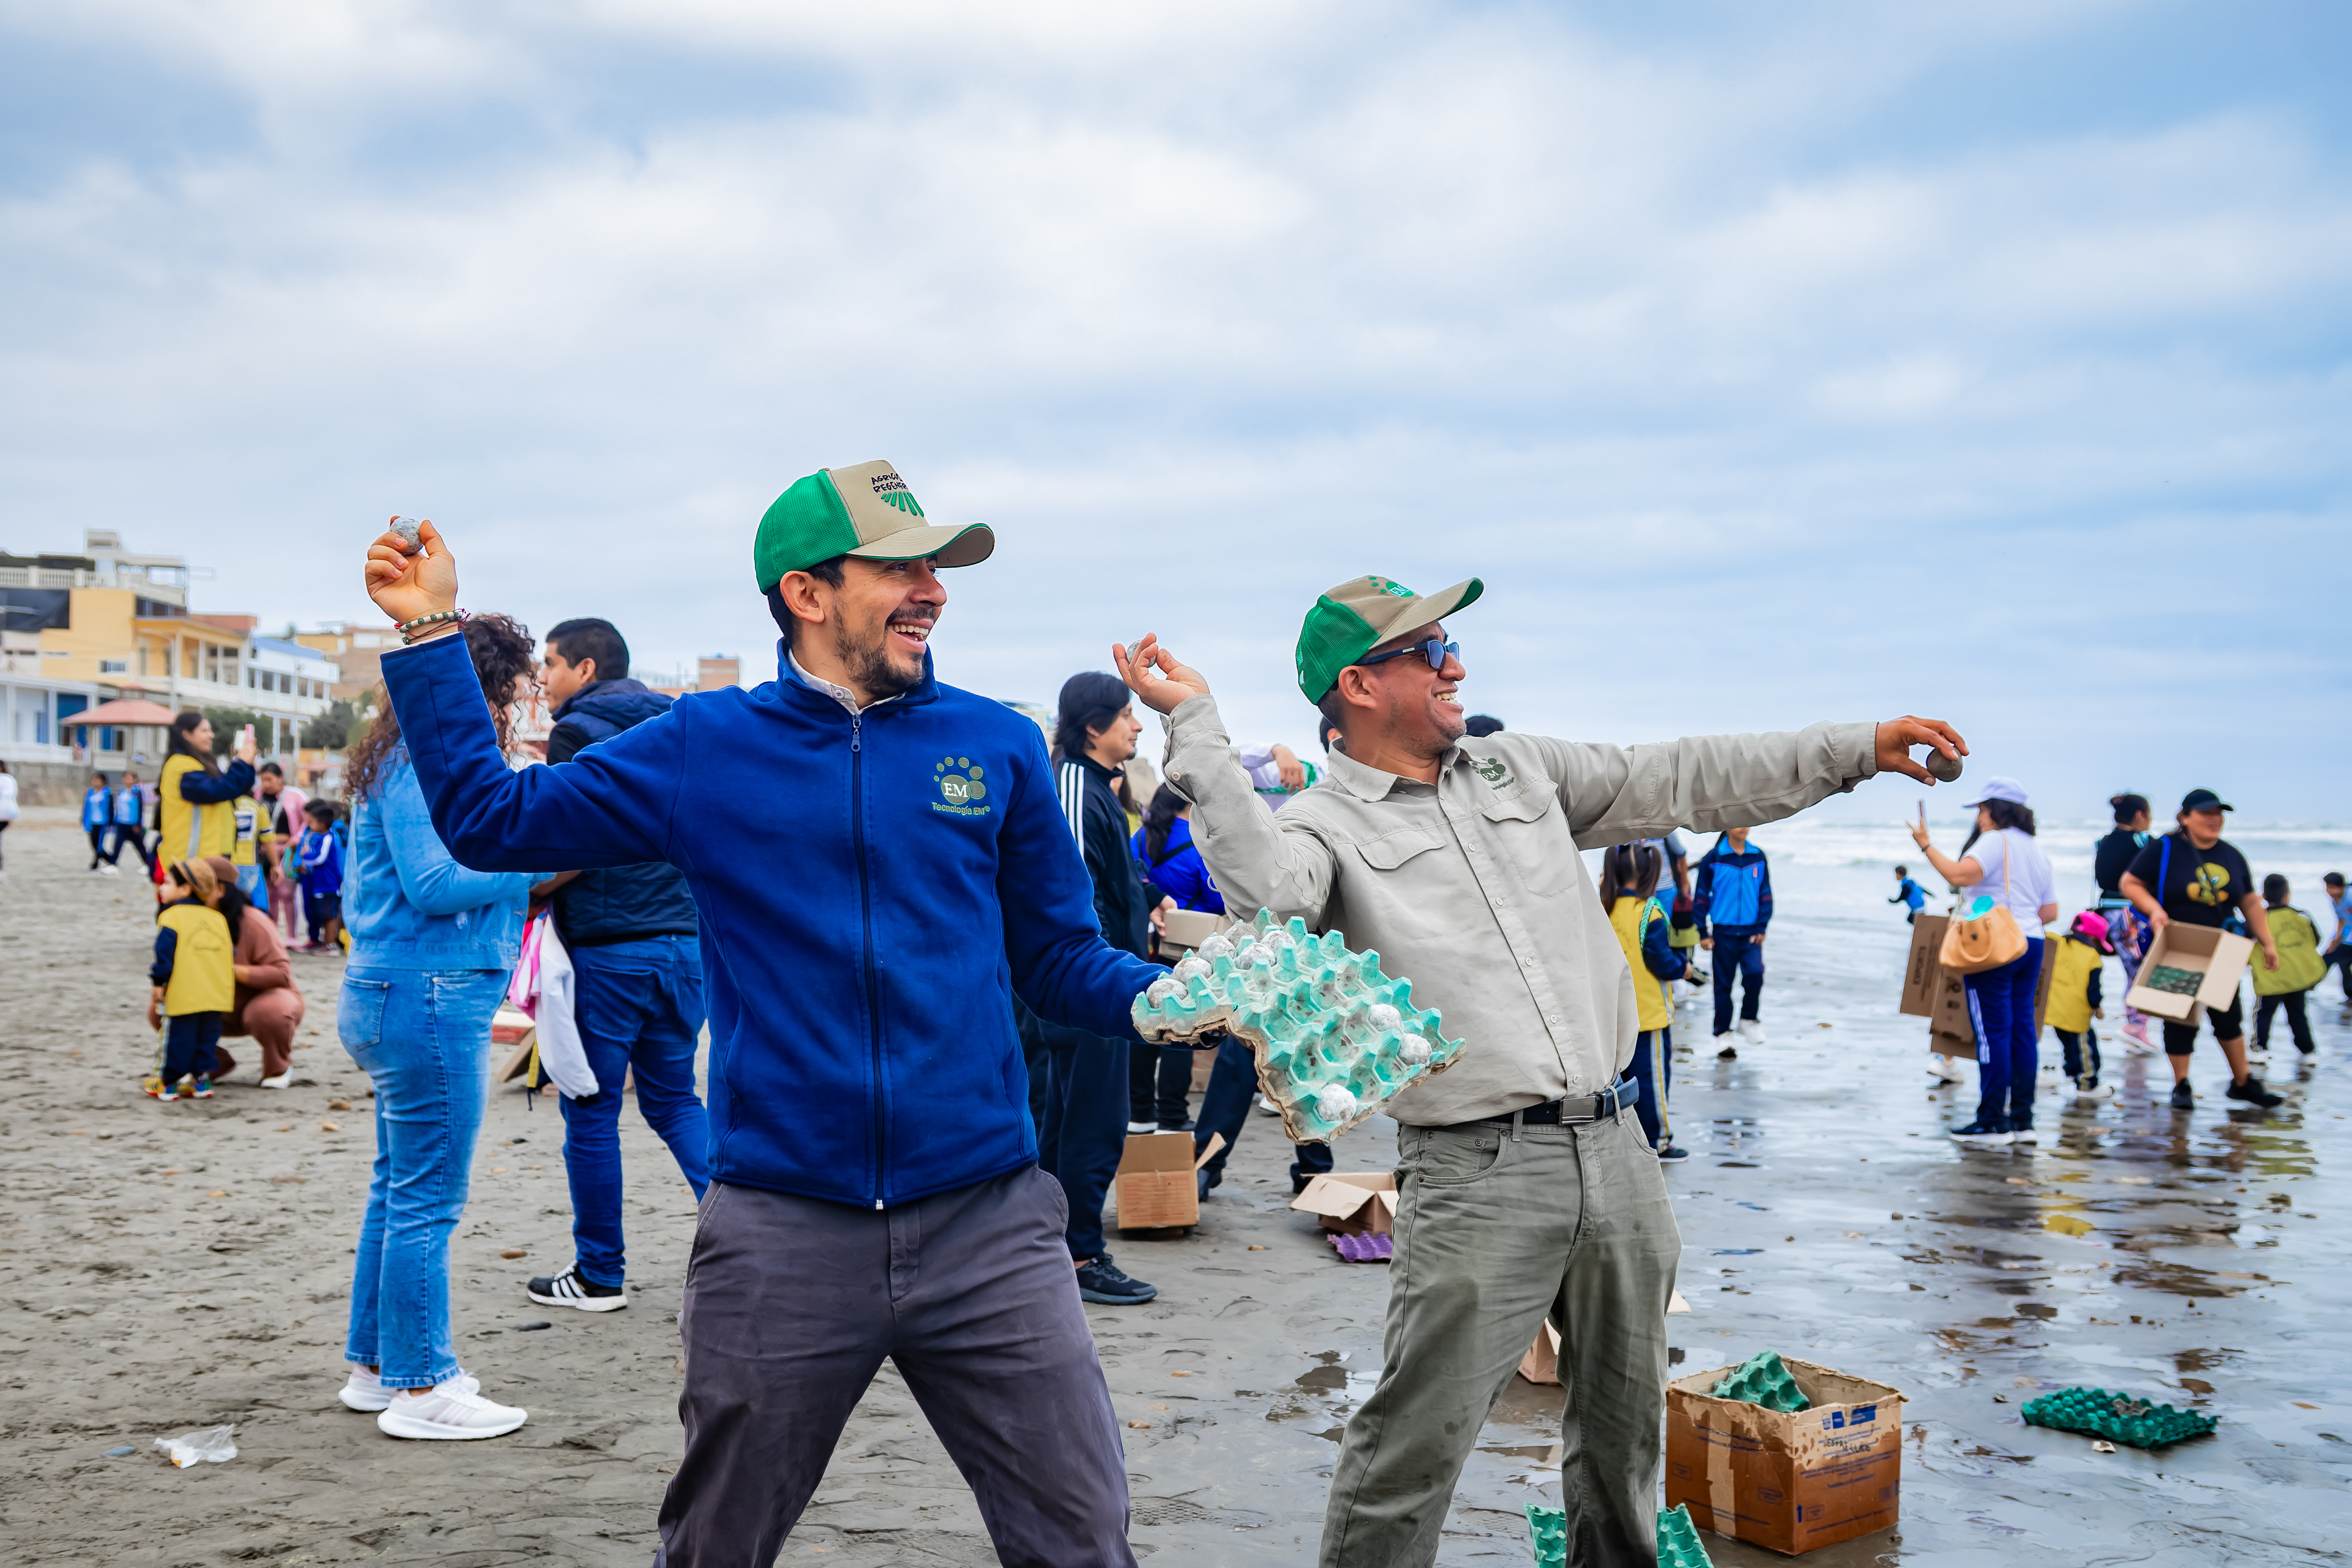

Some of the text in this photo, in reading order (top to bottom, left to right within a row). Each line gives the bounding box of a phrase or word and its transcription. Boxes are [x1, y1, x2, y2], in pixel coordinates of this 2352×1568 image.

[871, 472, 903, 485] AGRICUL
[873, 482, 908, 493] REGENER
[1482, 770, 1499, 780] EM
[944, 782, 969, 797] EM
[932, 801, 972, 816] Tecnología
